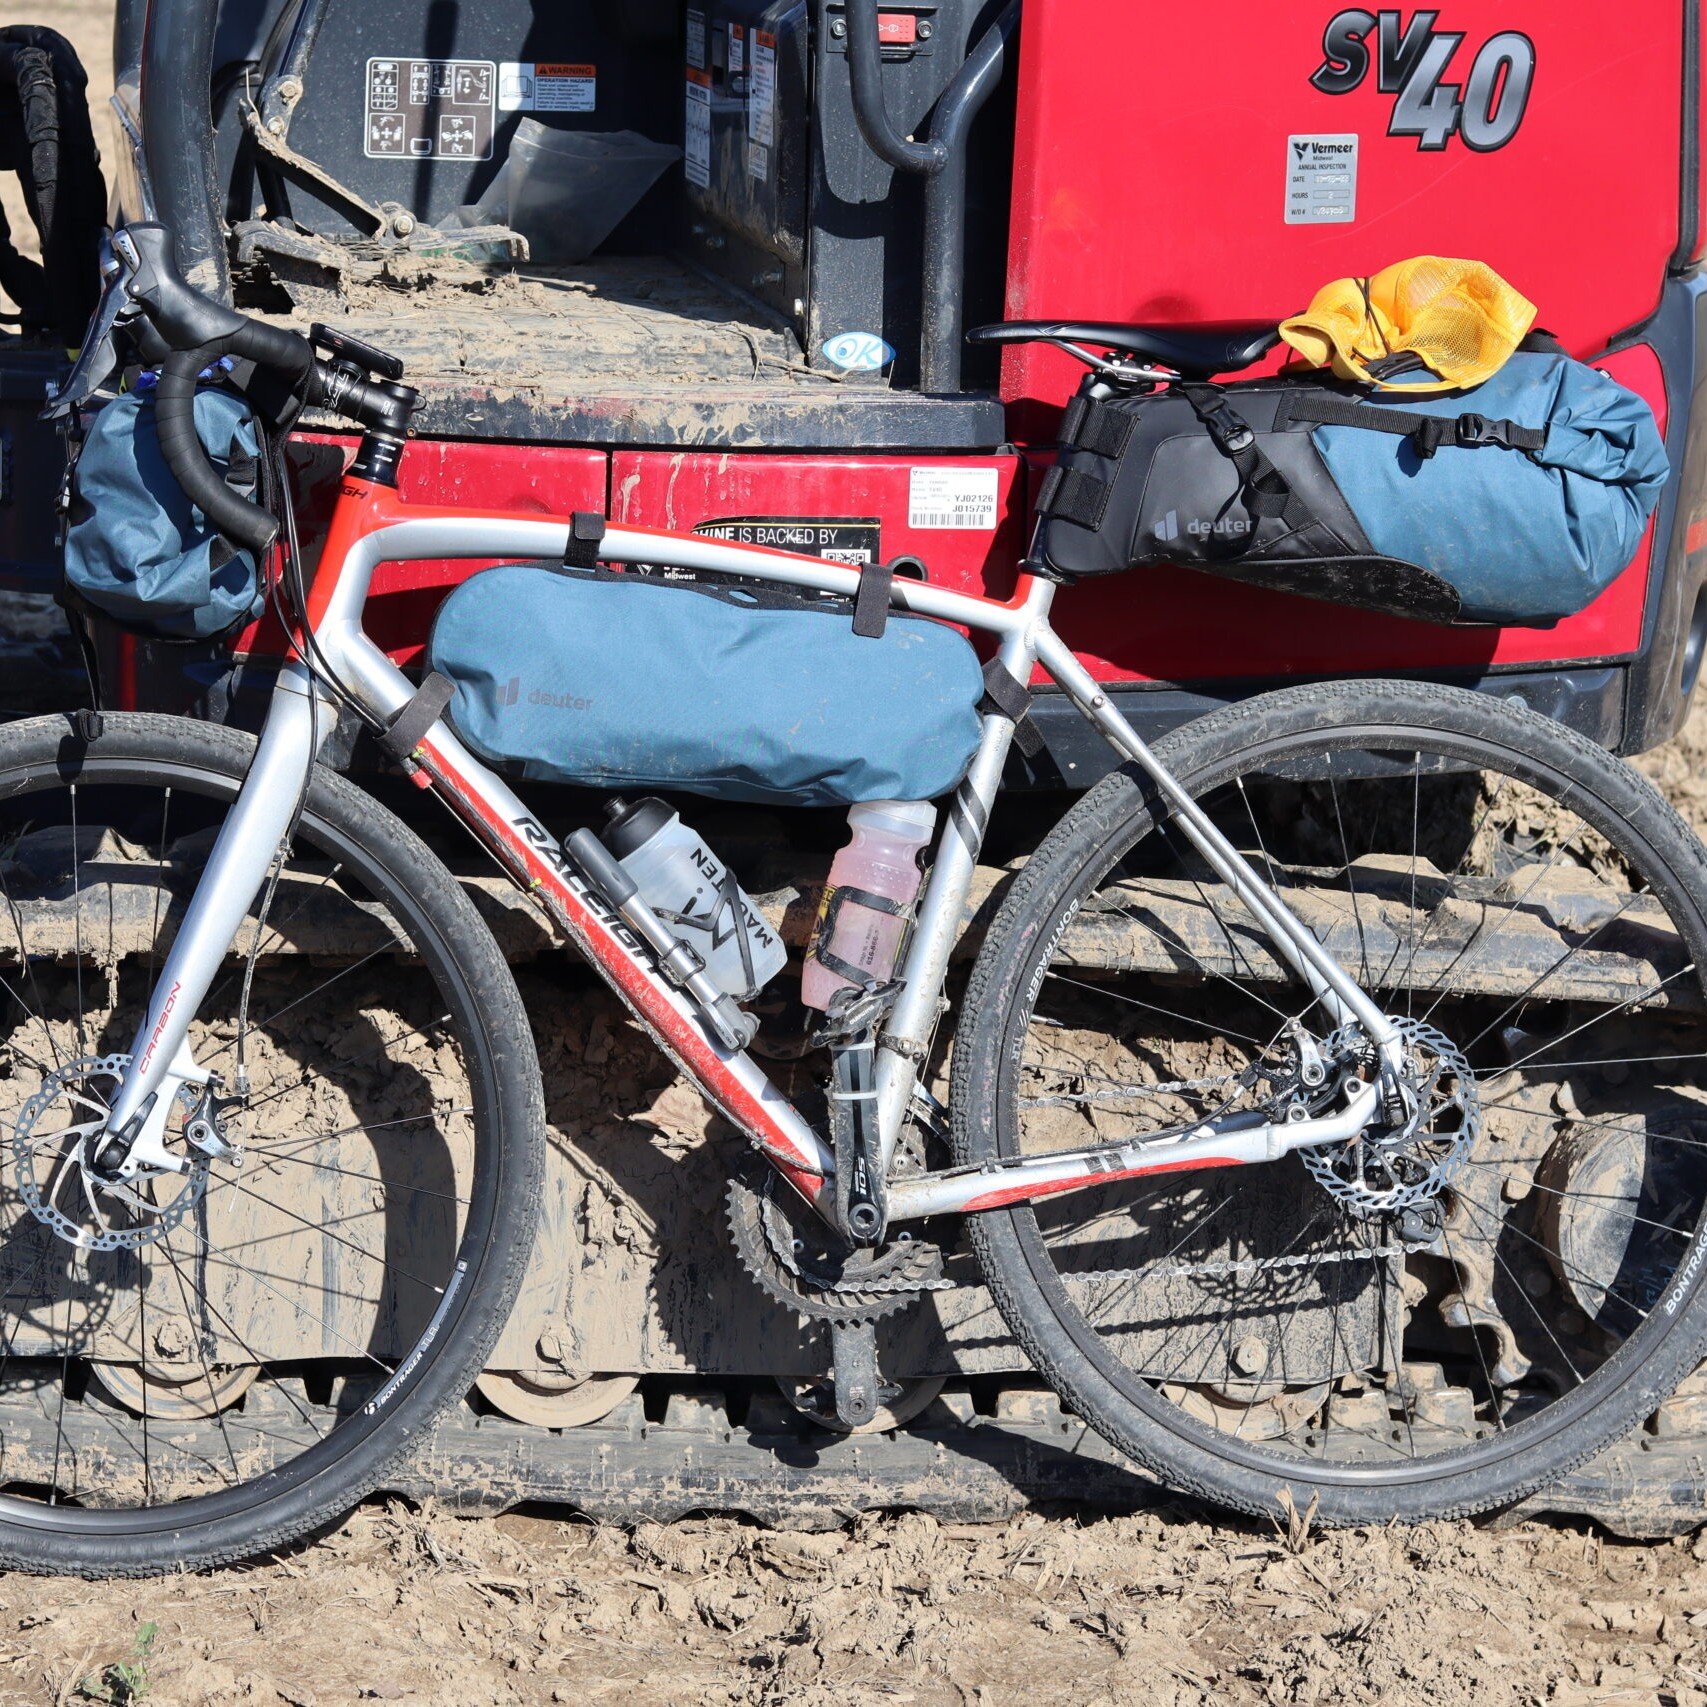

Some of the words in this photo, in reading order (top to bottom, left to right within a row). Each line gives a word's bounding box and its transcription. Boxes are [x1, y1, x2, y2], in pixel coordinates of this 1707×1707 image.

[550, 66, 593, 75] WARNING
[1311, 142, 1353, 154] Vermeer
[836, 338, 881, 364] OK
[955, 494, 994, 503] YJ02126
[952, 504, 992, 513] J015739
[1187, 517, 1253, 535] deuter
[691, 527, 735, 541] HINE
[739, 527, 752, 544] IS
[756, 527, 814, 544] BACKED
[819, 528, 838, 545] BY
[664, 572, 696, 581] Midwest
[527, 690, 594, 711] deuter
[1026, 898, 1079, 1002] BONTRAGER
[139, 981, 181, 1075] CARBON
[858, 1155, 867, 1195] 105
[380, 1352, 423, 1405] BONTRAGER
[421, 1327, 439, 1351] TLR
